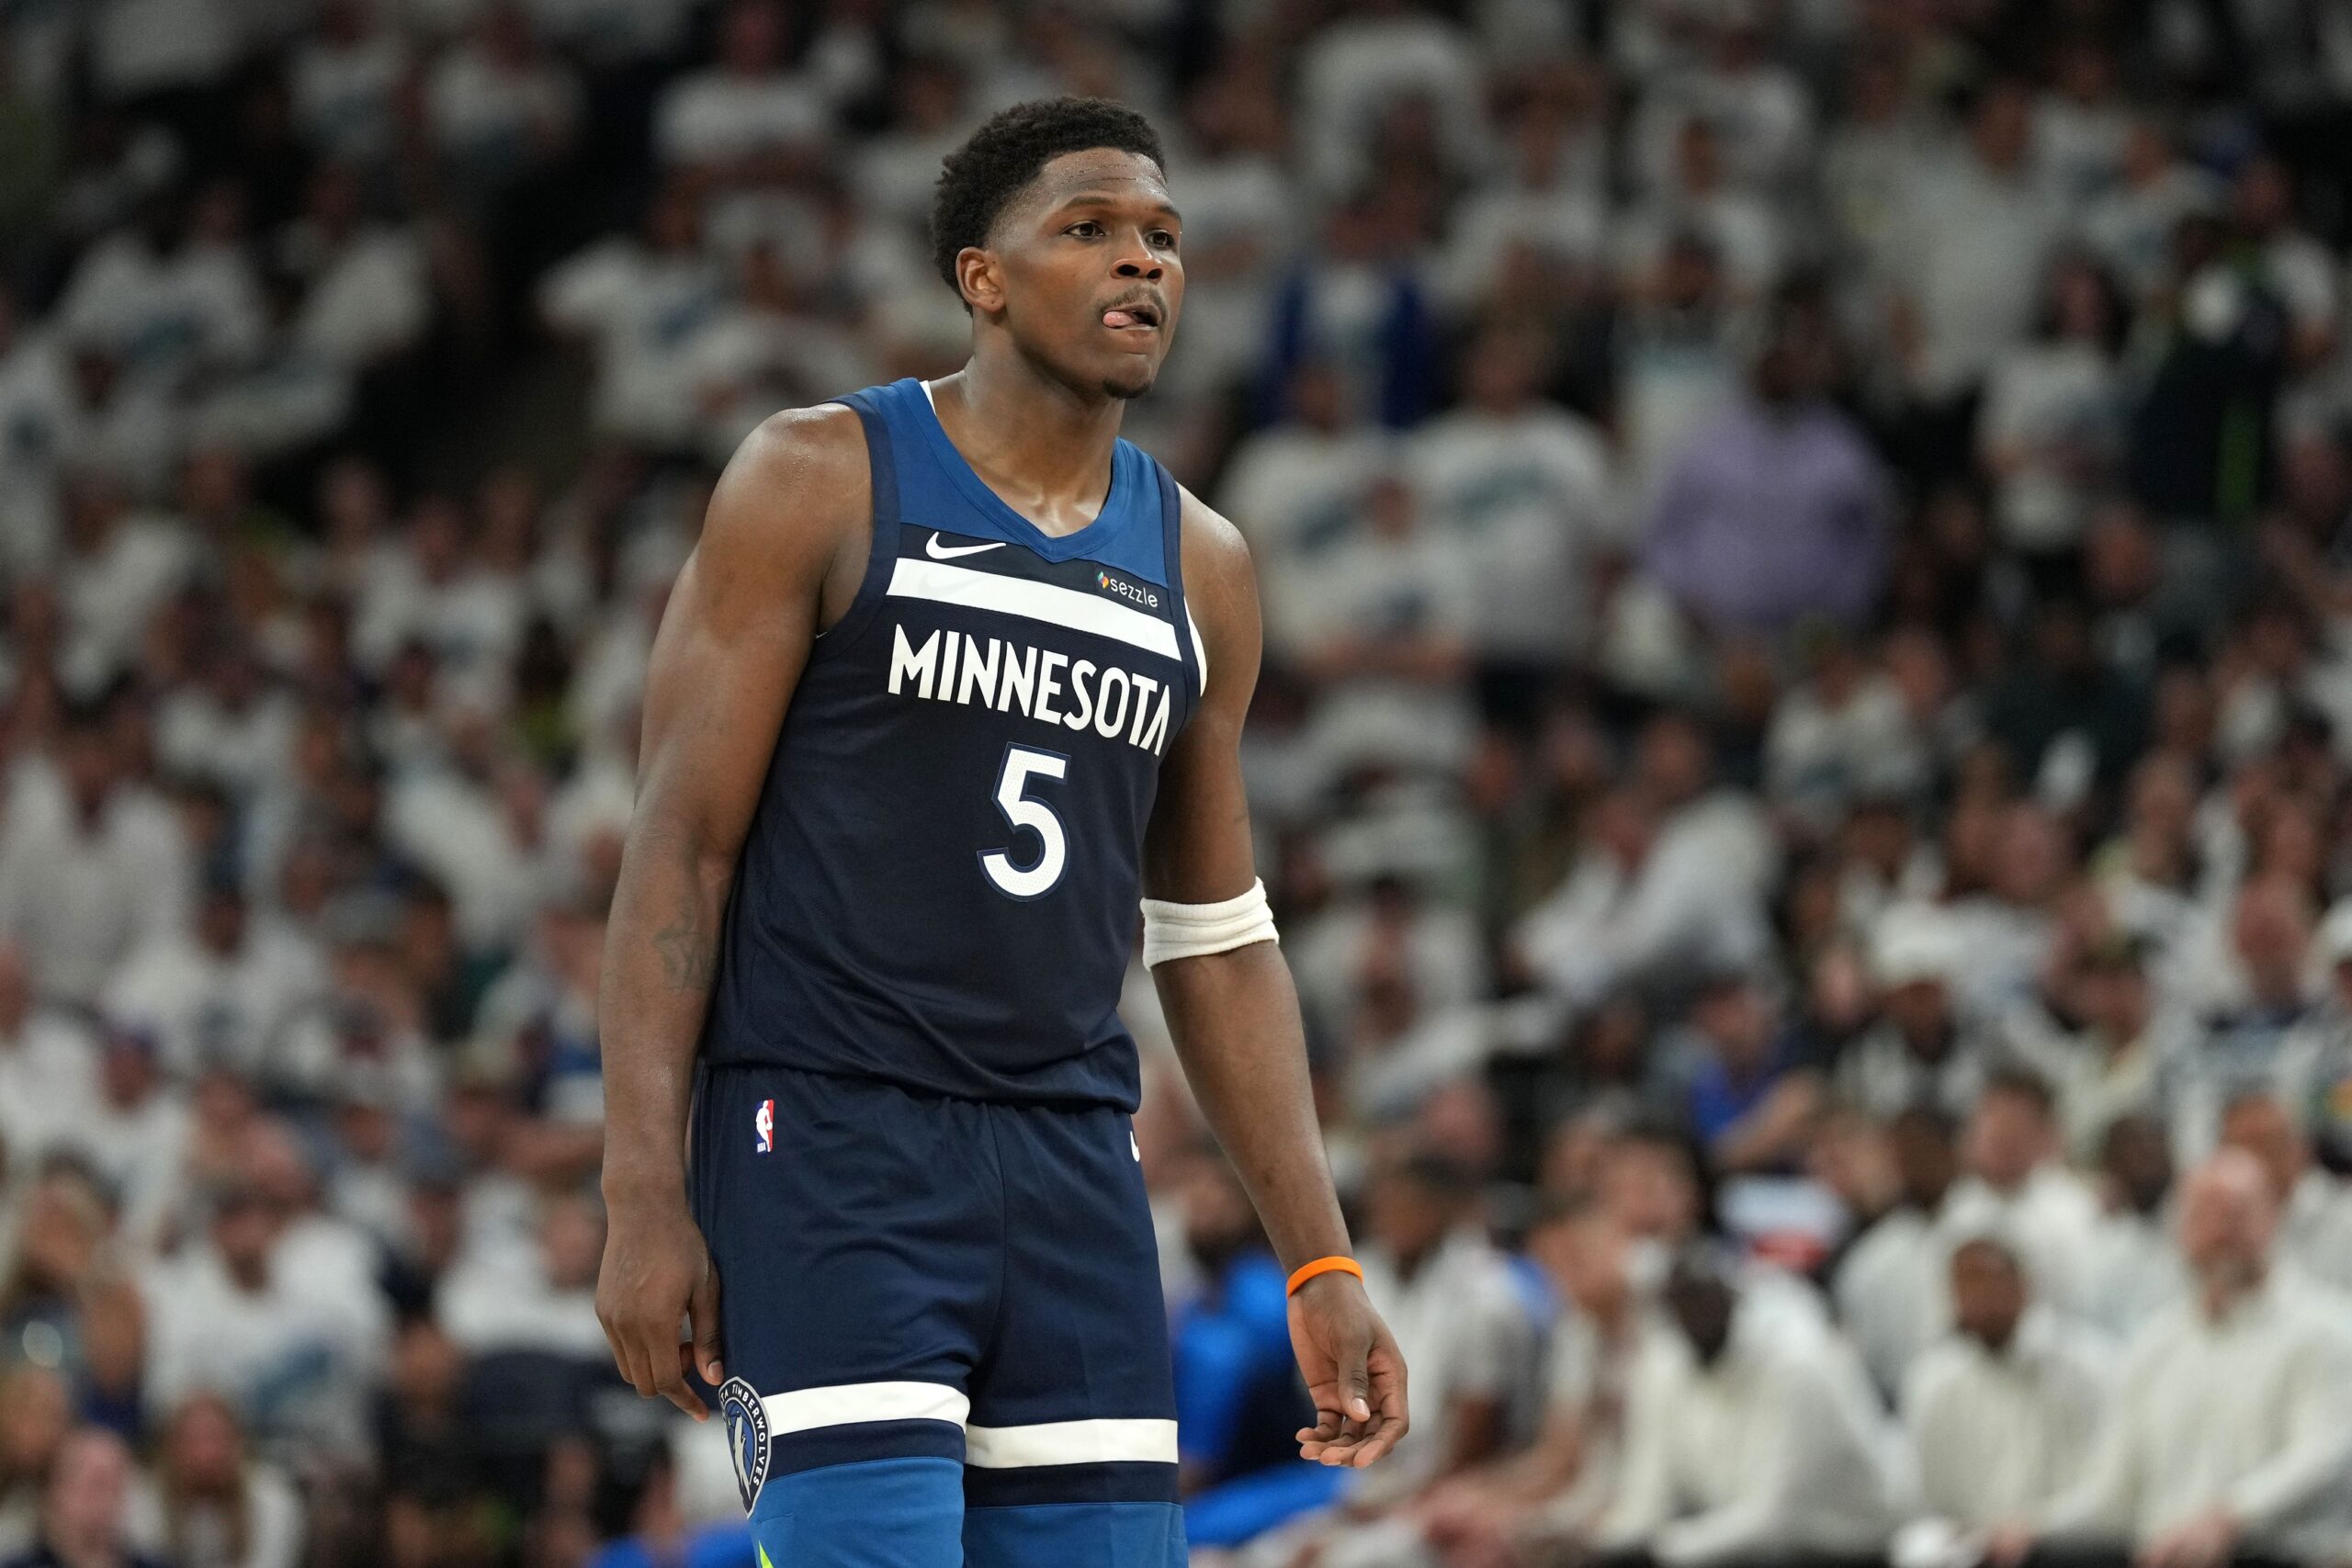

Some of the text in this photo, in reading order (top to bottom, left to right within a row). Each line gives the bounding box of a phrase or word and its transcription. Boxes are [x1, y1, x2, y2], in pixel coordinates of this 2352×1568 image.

[1109, 578, 1159, 608] sezzle
[888, 624, 1170, 757] MINNESOTA
[979, 745, 1069, 899] 5
[731, 1383, 766, 1487] TIMBERWOLVES
